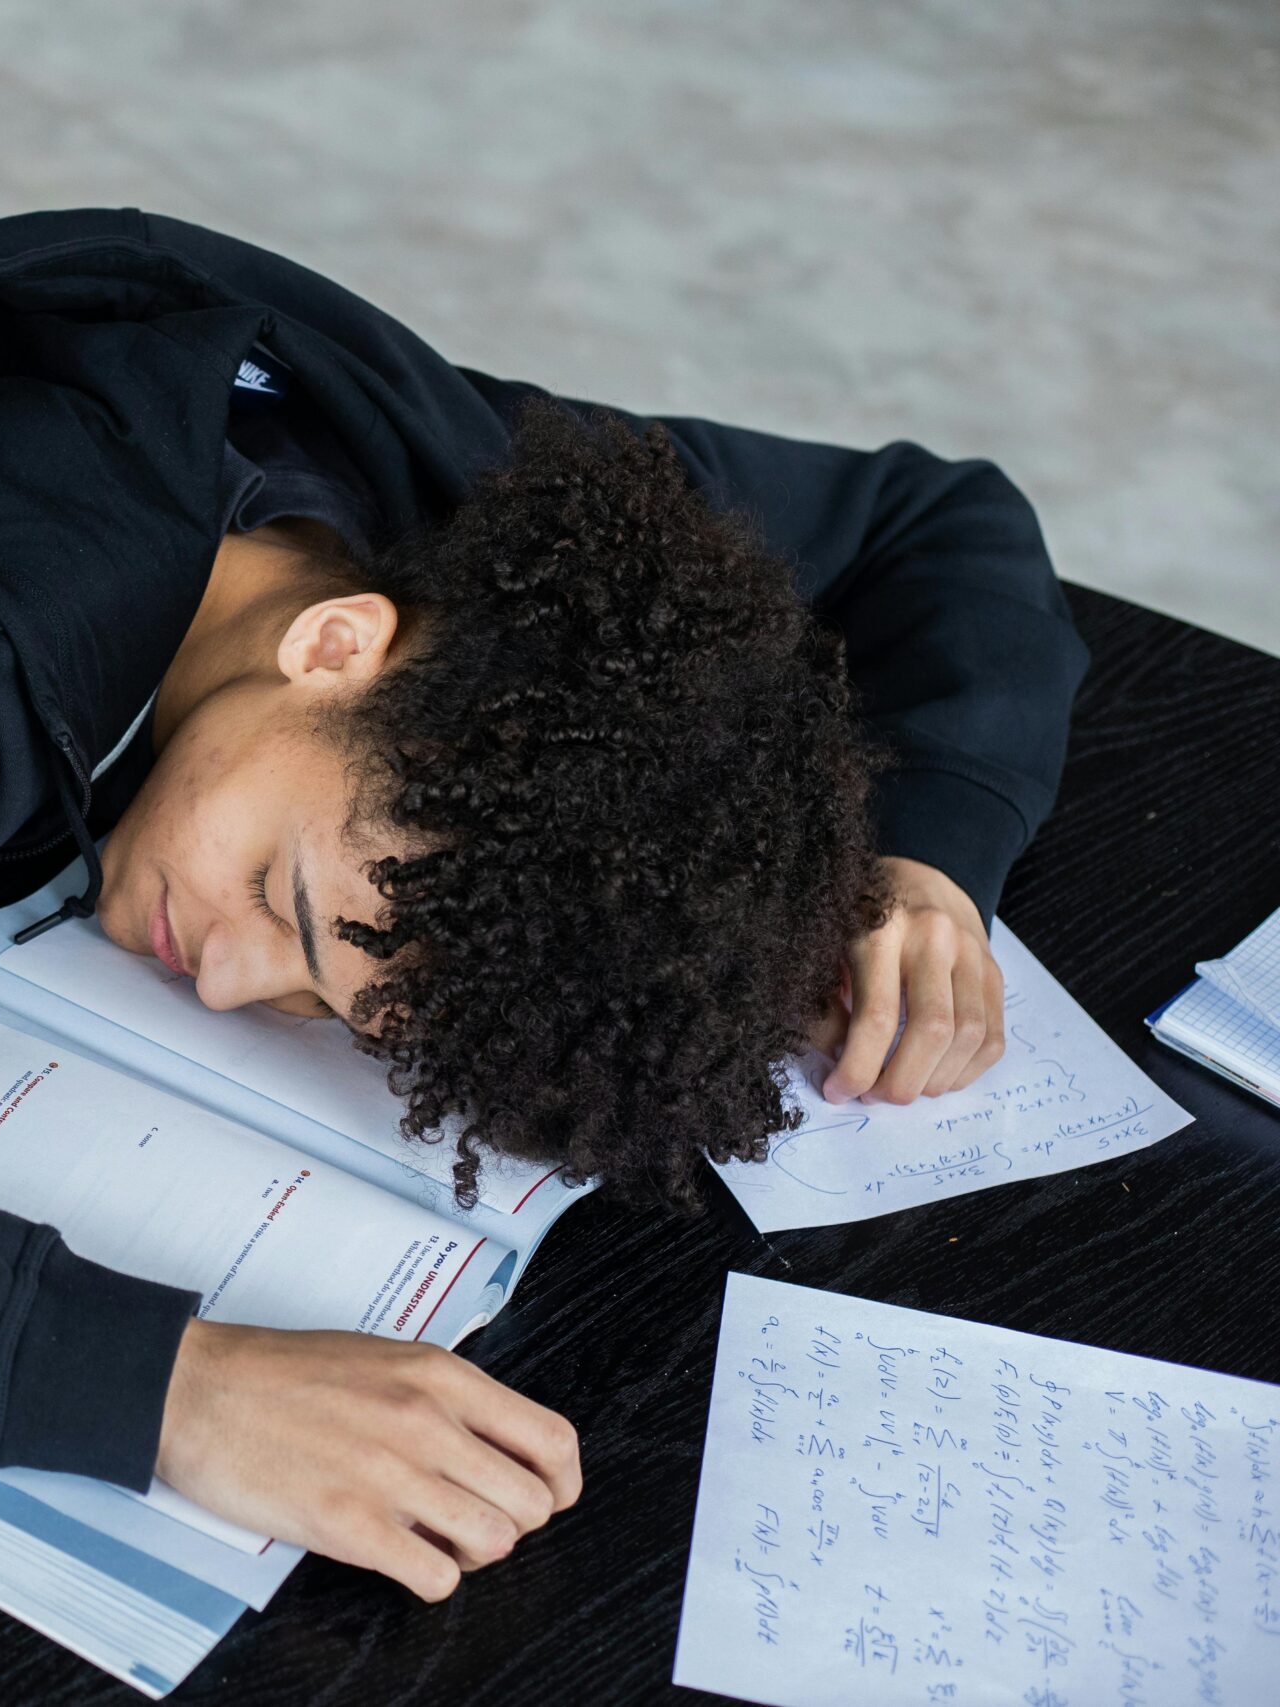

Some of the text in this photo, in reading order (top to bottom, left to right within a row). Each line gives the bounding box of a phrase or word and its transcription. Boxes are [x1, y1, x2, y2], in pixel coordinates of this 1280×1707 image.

[237, 359, 272, 386] NIKE
[20, 1069, 33, 1081] and
[40, 1067, 52, 1075] 15.
[0, 1078, 24, 1102] quadratic
[19, 1074, 44, 1096] Compare
[10, 1095, 22, 1108] and
[137, 1132, 153, 1148] none
[292, 1175, 305, 1184] 14.
[261, 1186, 273, 1198] two
[265, 1184, 297, 1221] Open-Ended
[252, 1221, 270, 1239] Write
[427, 1234, 440, 1243] 13.
[233, 1242, 253, 1265] system
[402, 1239, 422, 1259] Which
[419, 1244, 432, 1257] Use
[229, 1264, 238, 1274] of
[410, 1255, 423, 1269] two
[385, 1258, 406, 1285] method
[216, 1271, 235, 1292] linear
[380, 1282, 391, 1293] do
[392, 1240, 458, 1332] Do you UNDERSTAND?
[393, 1267, 415, 1295] different
[207, 1290, 220, 1306] and
[371, 1290, 384, 1305] you
[357, 1303, 375, 1329] prefer?
[374, 1293, 397, 1323] methods
[369, 1322, 379, 1331] to
